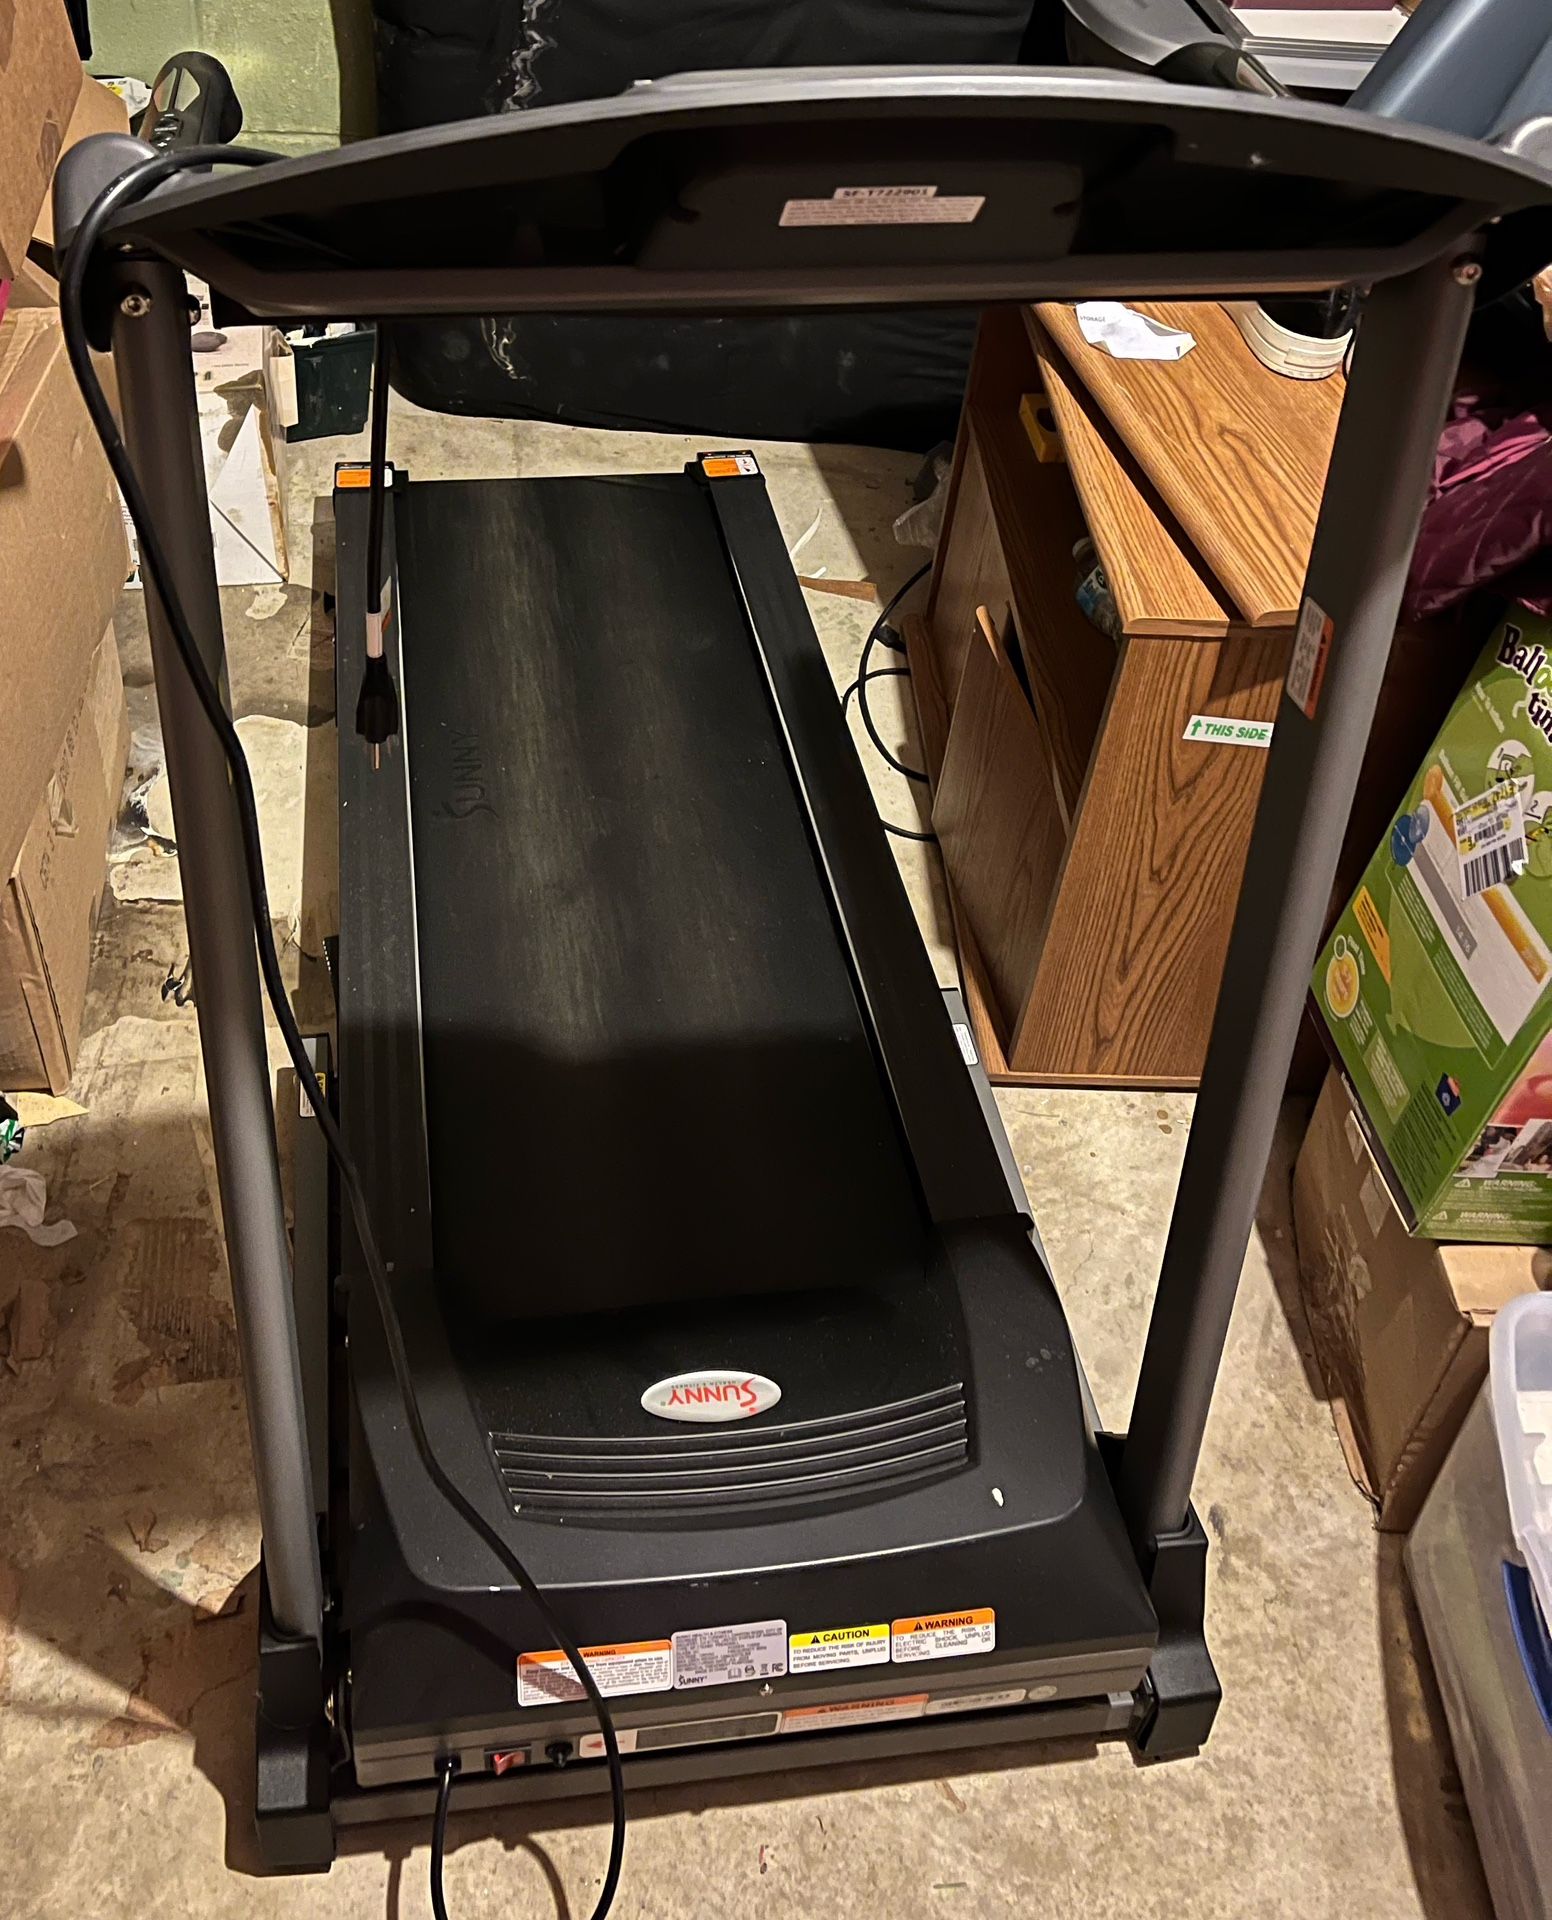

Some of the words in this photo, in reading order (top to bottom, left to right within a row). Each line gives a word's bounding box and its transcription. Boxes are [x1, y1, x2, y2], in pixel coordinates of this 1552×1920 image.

[1204, 723, 1234, 737] THIS
[1236, 726, 1269, 740] SIDE
[667, 1377, 757, 1413] SUNNY
[924, 1615, 974, 1630] WARNING
[823, 1629, 870, 1642] CAUTION
[802, 1646, 826, 1654] REDUCE
[862, 1646, 887, 1654] UNPLUG
[895, 1639, 927, 1648] ELECTRIC
[582, 1649, 617, 1658] WARNING
[678, 1674, 705, 1687] SUNNY
